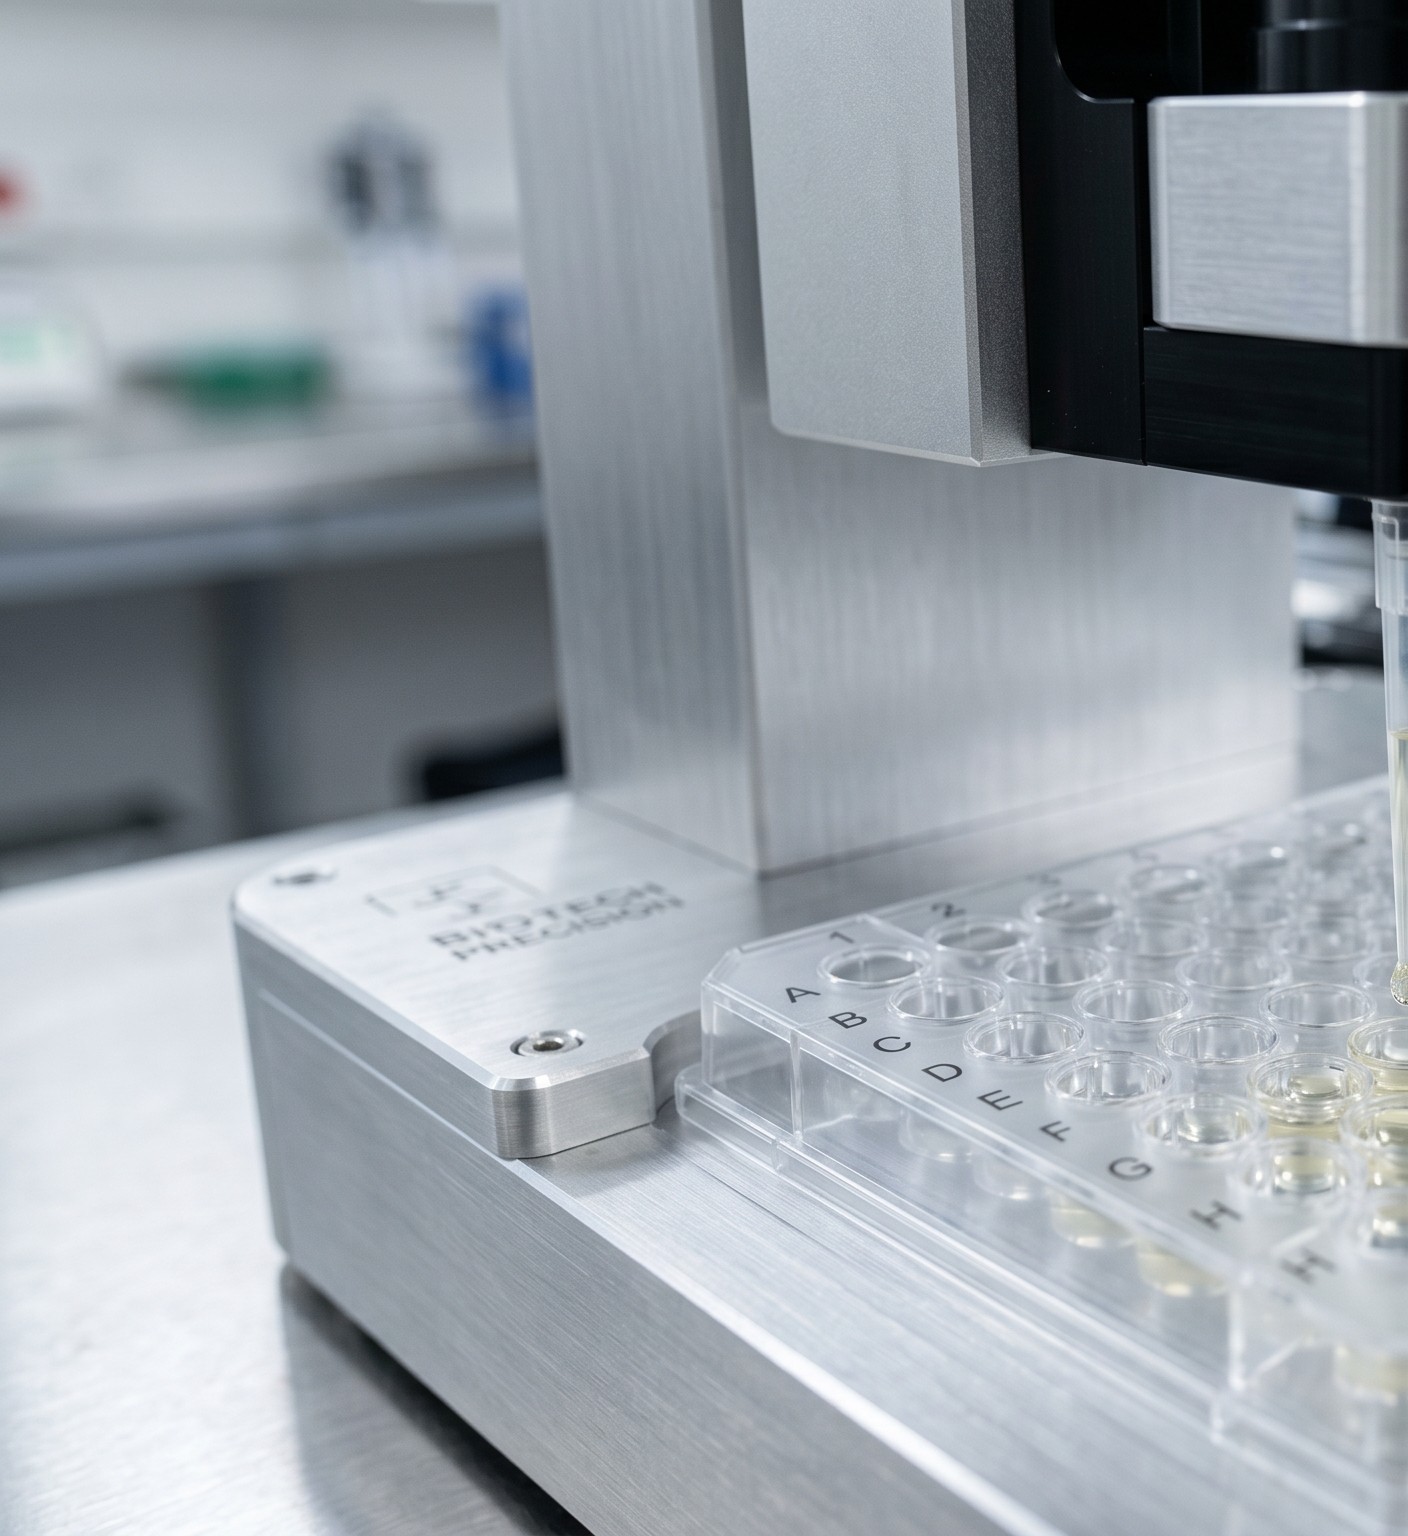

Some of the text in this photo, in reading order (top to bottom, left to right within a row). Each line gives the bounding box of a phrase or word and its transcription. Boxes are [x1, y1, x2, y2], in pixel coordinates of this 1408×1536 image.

[829, 930, 855, 944] 1
[785, 986, 821, 1004] A
[828, 1011, 867, 1029] B
[873, 1036, 911, 1053] C
[921, 1063, 962, 1083] D
[977, 1089, 1023, 1111] E
[1040, 1120, 1071, 1142] F
[1108, 1157, 1153, 1181] G
[1190, 1200, 1242, 1231] H
[1281, 1250, 1334, 1283] H
